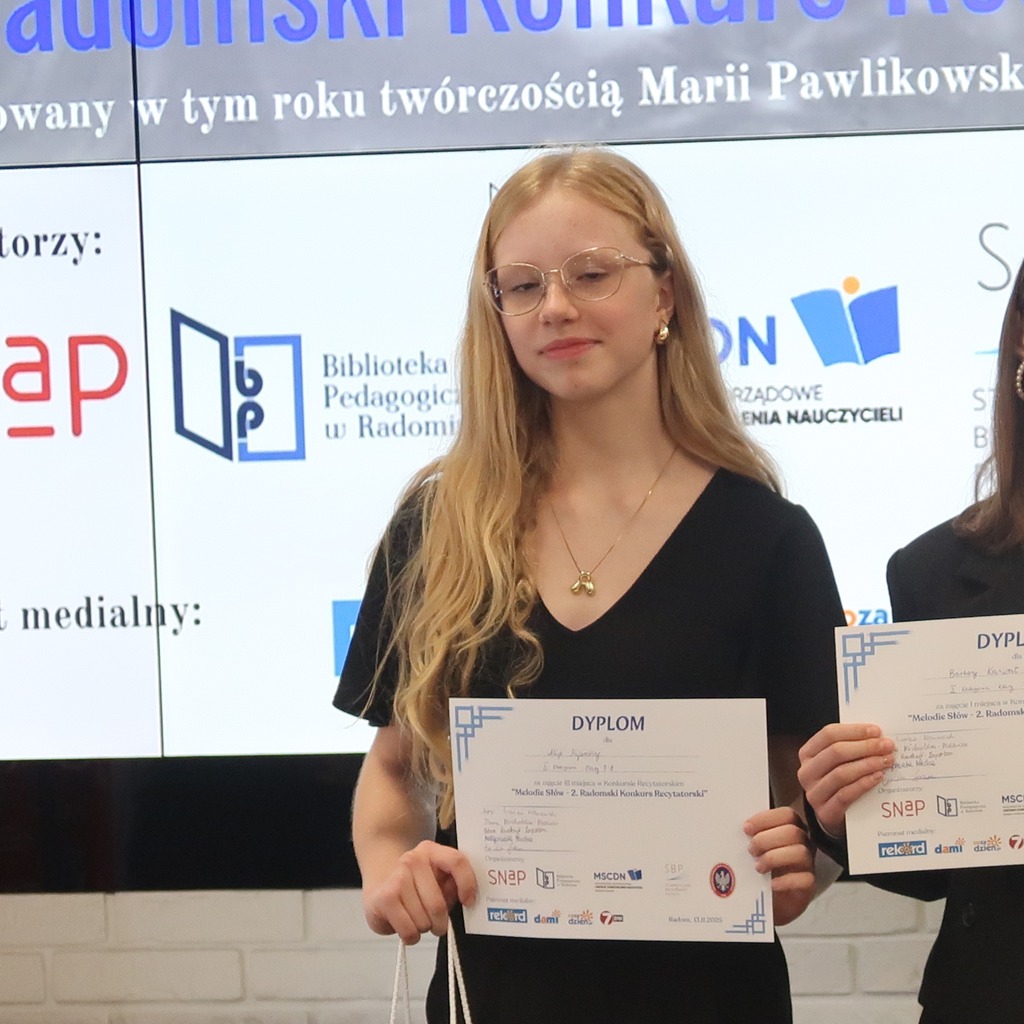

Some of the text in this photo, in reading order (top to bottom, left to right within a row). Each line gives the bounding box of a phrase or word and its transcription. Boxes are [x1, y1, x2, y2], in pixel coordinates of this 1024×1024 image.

[139, 97, 168, 125] w
[183, 88, 259, 133] tym
[274, 80, 366, 120] roku
[380, 70, 622, 117] twórczością
[638, 63, 751, 106] Marii
[0, 231, 102, 265] torzy:
[323, 351, 448, 378] Biblioteka
[787, 406, 903, 424] NAUCZYCIELI
[325, 414, 459, 439] w Radomi
[21, 596, 201, 635] medialny:
[572, 716, 645, 731] DYPLOM
[580, 789, 619, 797] Radomski
[620, 789, 653, 797] Konkurs
[593, 872, 626, 880] MSCDN
[664, 863, 684, 873] SBP
